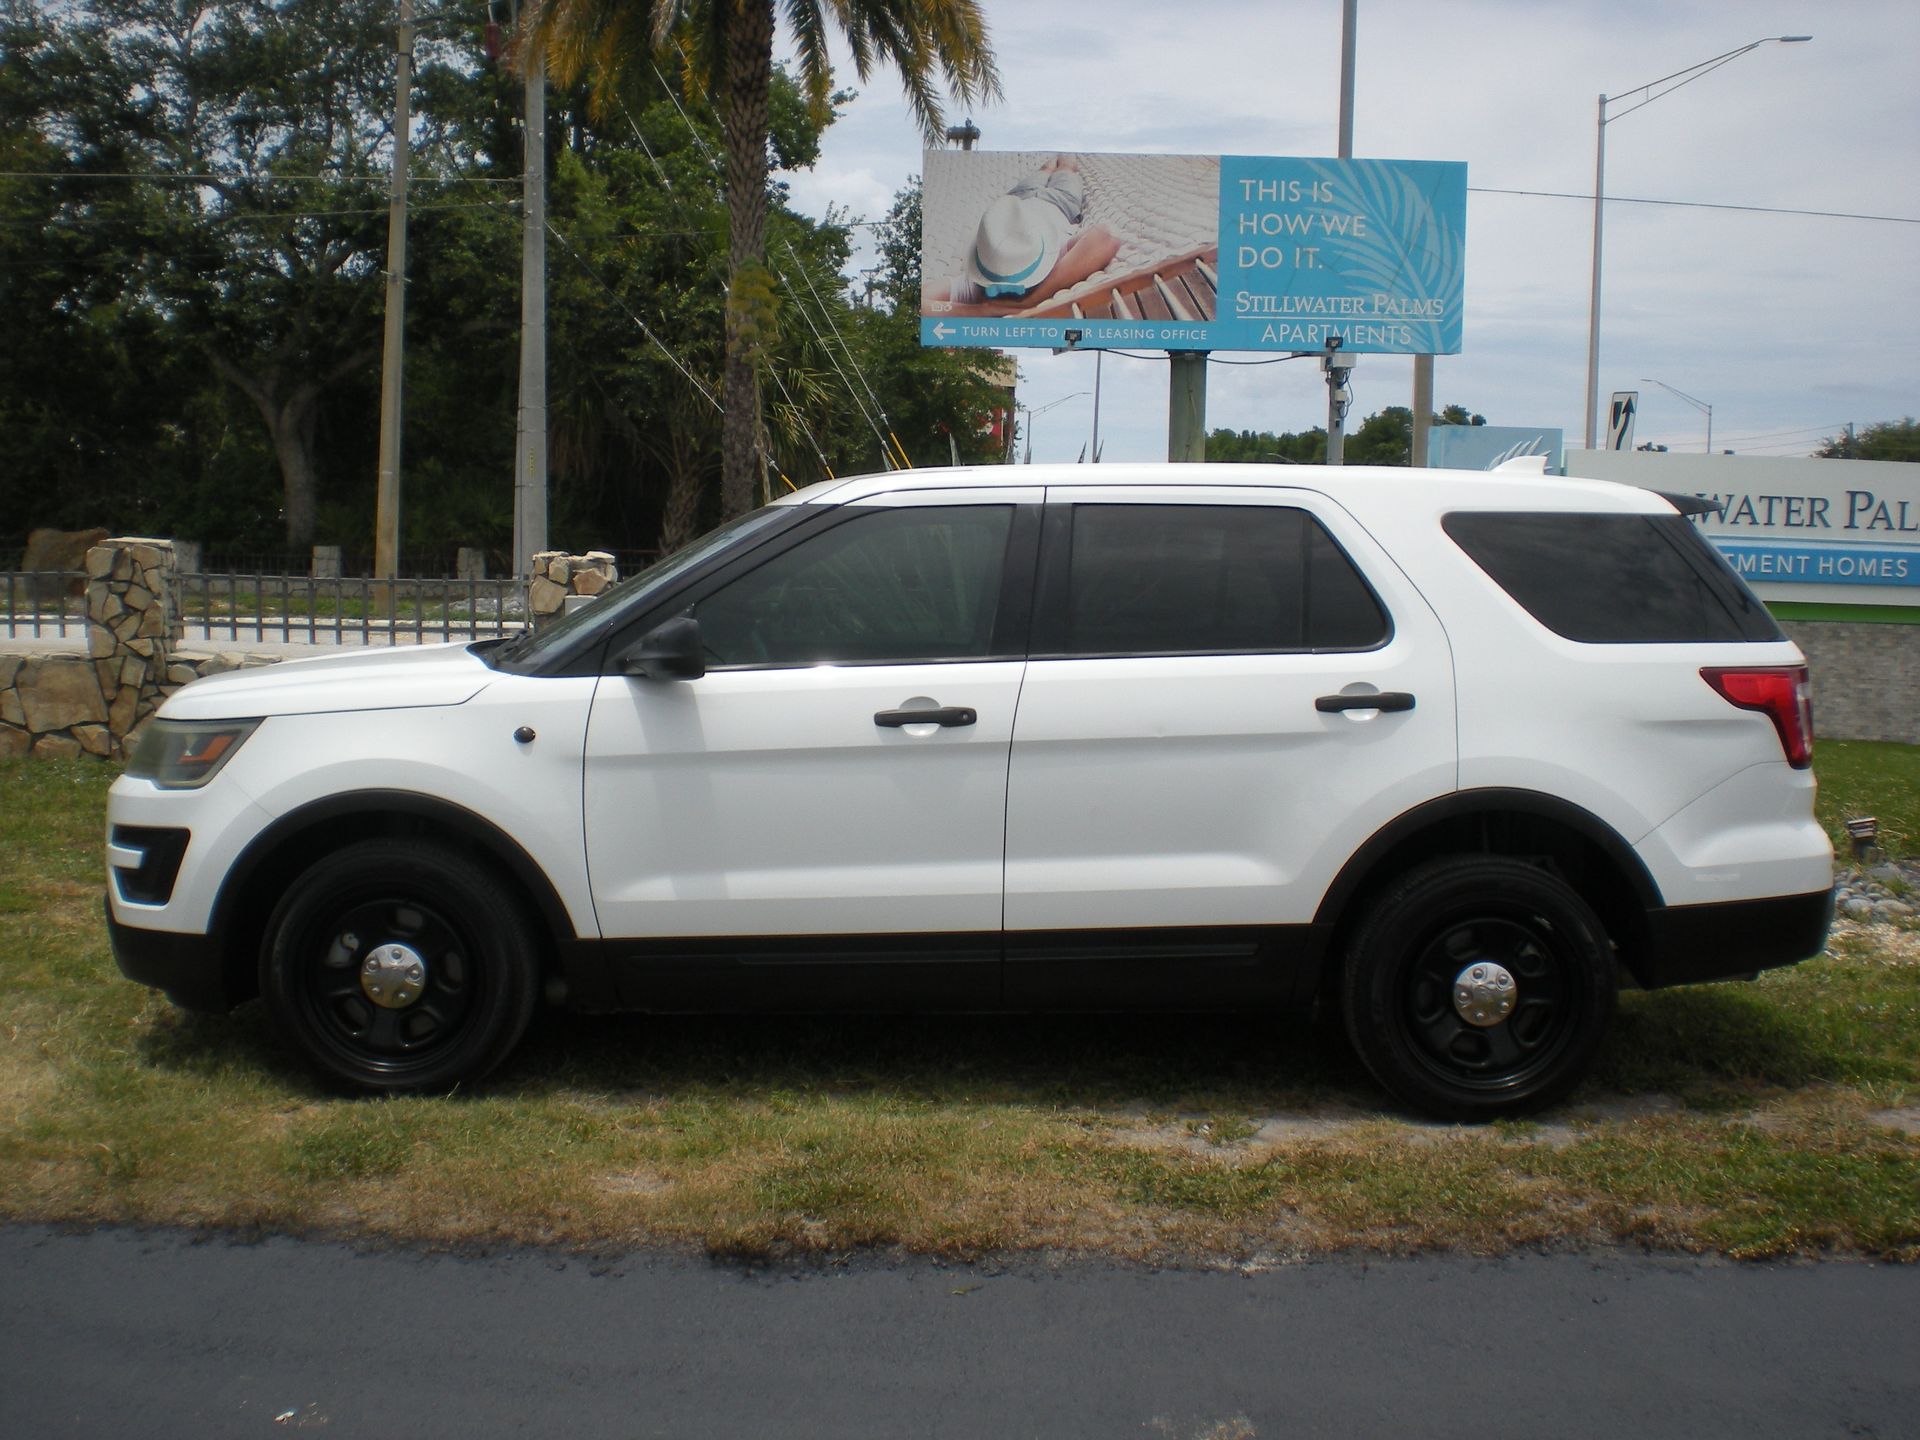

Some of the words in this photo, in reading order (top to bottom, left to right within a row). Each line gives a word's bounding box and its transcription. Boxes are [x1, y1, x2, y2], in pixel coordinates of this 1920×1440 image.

[1239, 180, 1301, 203] THIS
[1311, 181, 1334, 204] IS
[1239, 213, 1314, 236] HOW
[1321, 215, 1366, 237] WE
[1238, 247, 1283, 269] DO
[1295, 248, 1323, 270] IT.
[1235, 291, 1366, 314] STILLWATER
[1372, 293, 1444, 316] PALMS
[962, 326, 999, 337] TURN
[1005, 327, 1035, 338] LEFT
[1039, 327, 1058, 338] TO
[1098, 328, 1155, 340] LEASING
[1160, 329, 1207, 341] OFFICE
[1261, 323, 1412, 345] APARTMENTS
[1690, 493, 1831, 529] WATER
[1843, 490, 1920, 532] PAL
[1818, 556, 1909, 579] HOMES
